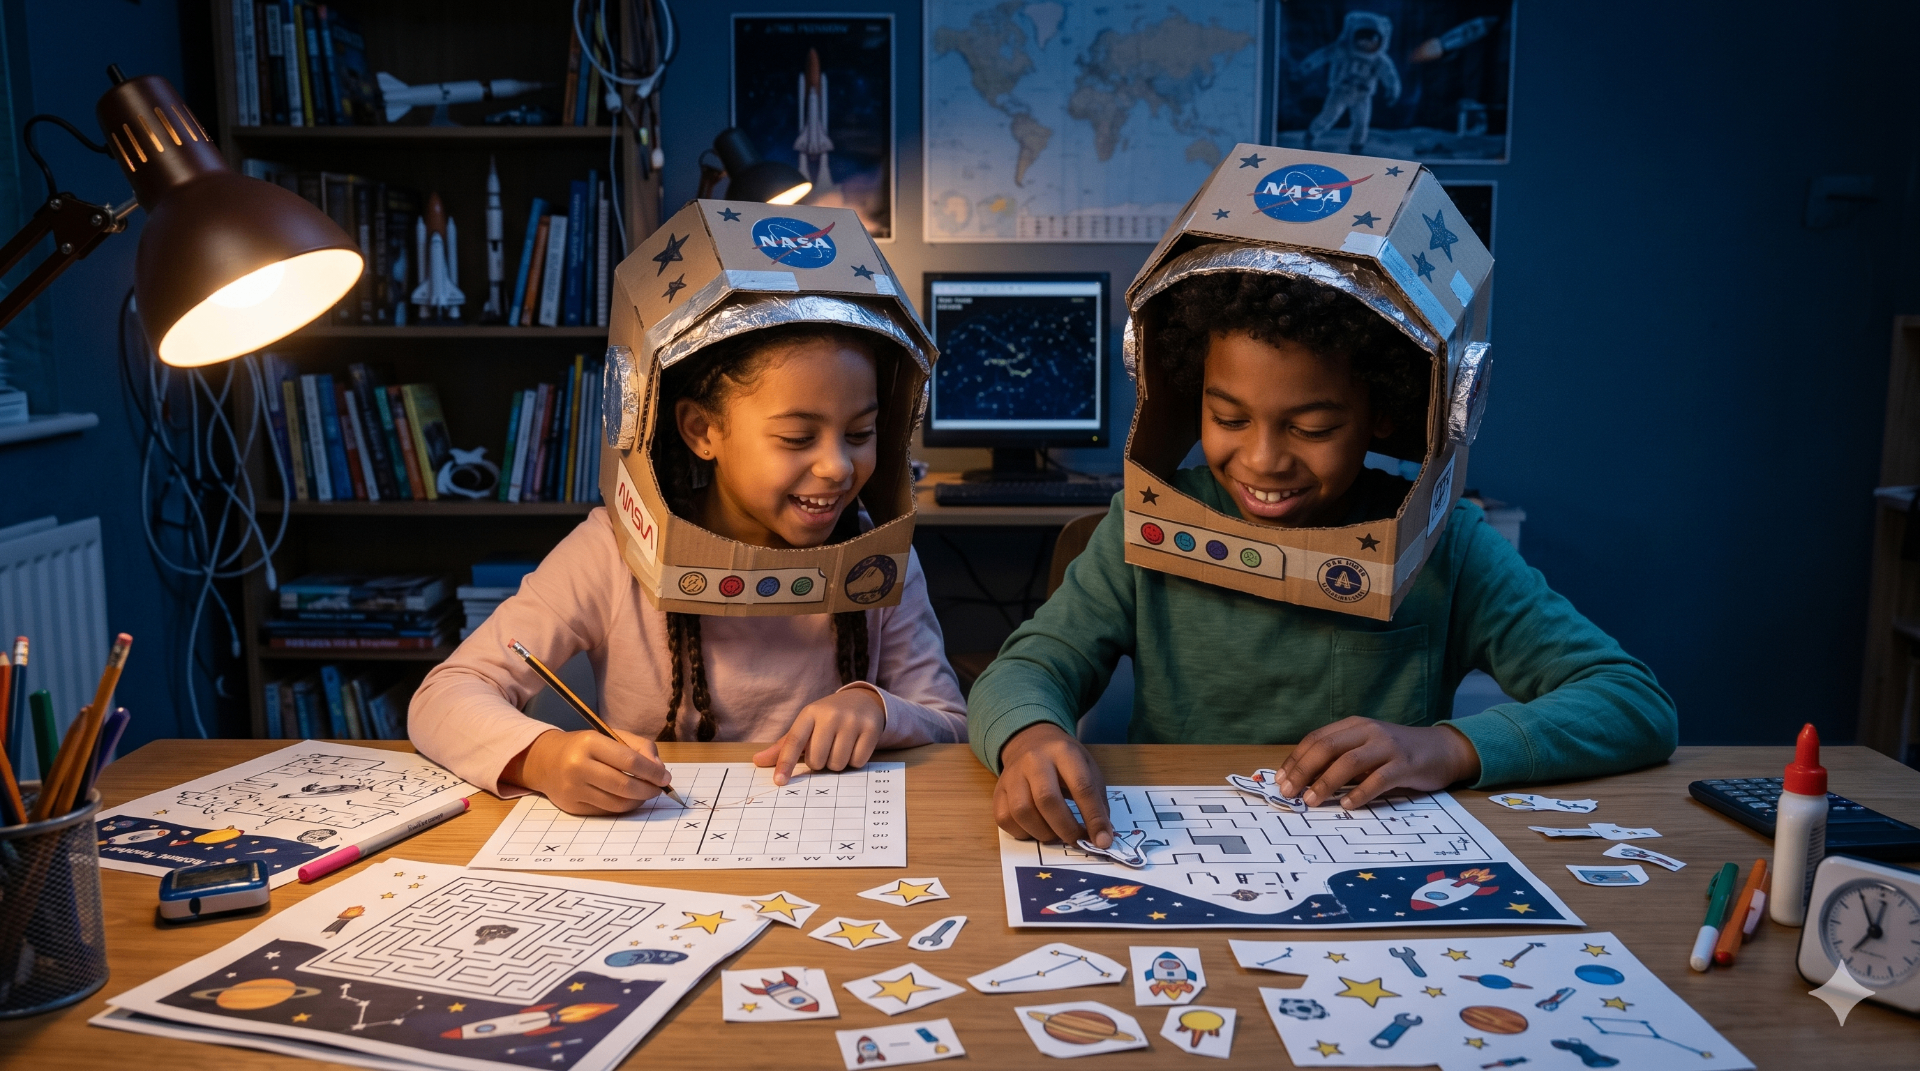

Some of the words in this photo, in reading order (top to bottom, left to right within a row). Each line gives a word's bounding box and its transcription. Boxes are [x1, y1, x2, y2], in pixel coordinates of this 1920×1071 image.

[1262, 181, 1342, 203] NASA
[759, 234, 832, 249] NASA
[618, 481, 654, 551] NASA
